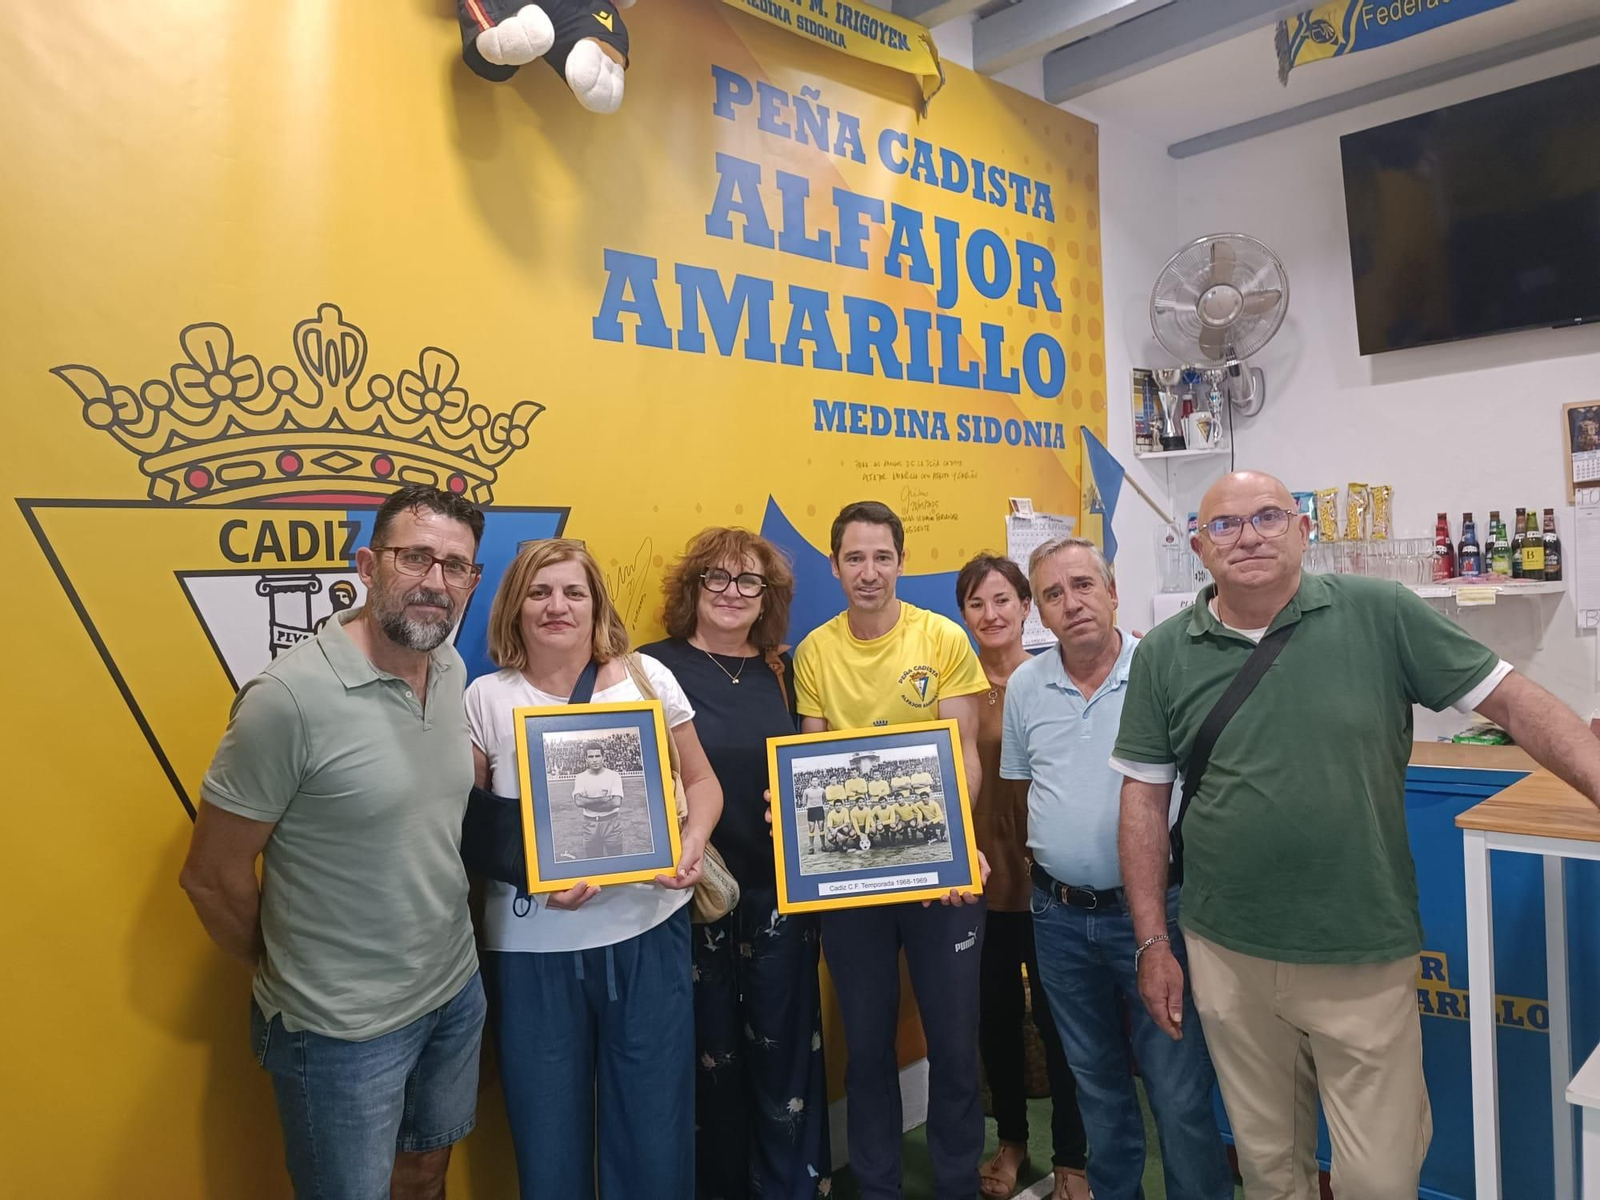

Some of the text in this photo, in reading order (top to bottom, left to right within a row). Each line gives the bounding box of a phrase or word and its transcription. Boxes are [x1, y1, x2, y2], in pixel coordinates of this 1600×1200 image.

[796, 14, 847, 49] SIDONIA
[834, 3, 912, 51] IRIGOYEN
[711, 64, 1056, 223] PEÑA CADISTA
[704, 152, 1062, 313] ALFAJOR
[592, 247, 1067, 399] AMARILLO
[813, 398, 1066, 450] MEDINA SIDONIA
[219, 519, 362, 563] CADIZ
[898, 665, 939, 684] PEÑA CADISTA
[829, 884, 847, 892] Cadiz
[861, 880, 895, 890] Temporada
[896, 876, 928, 886] 1968-1969
[954, 937, 975, 953] PUMA
